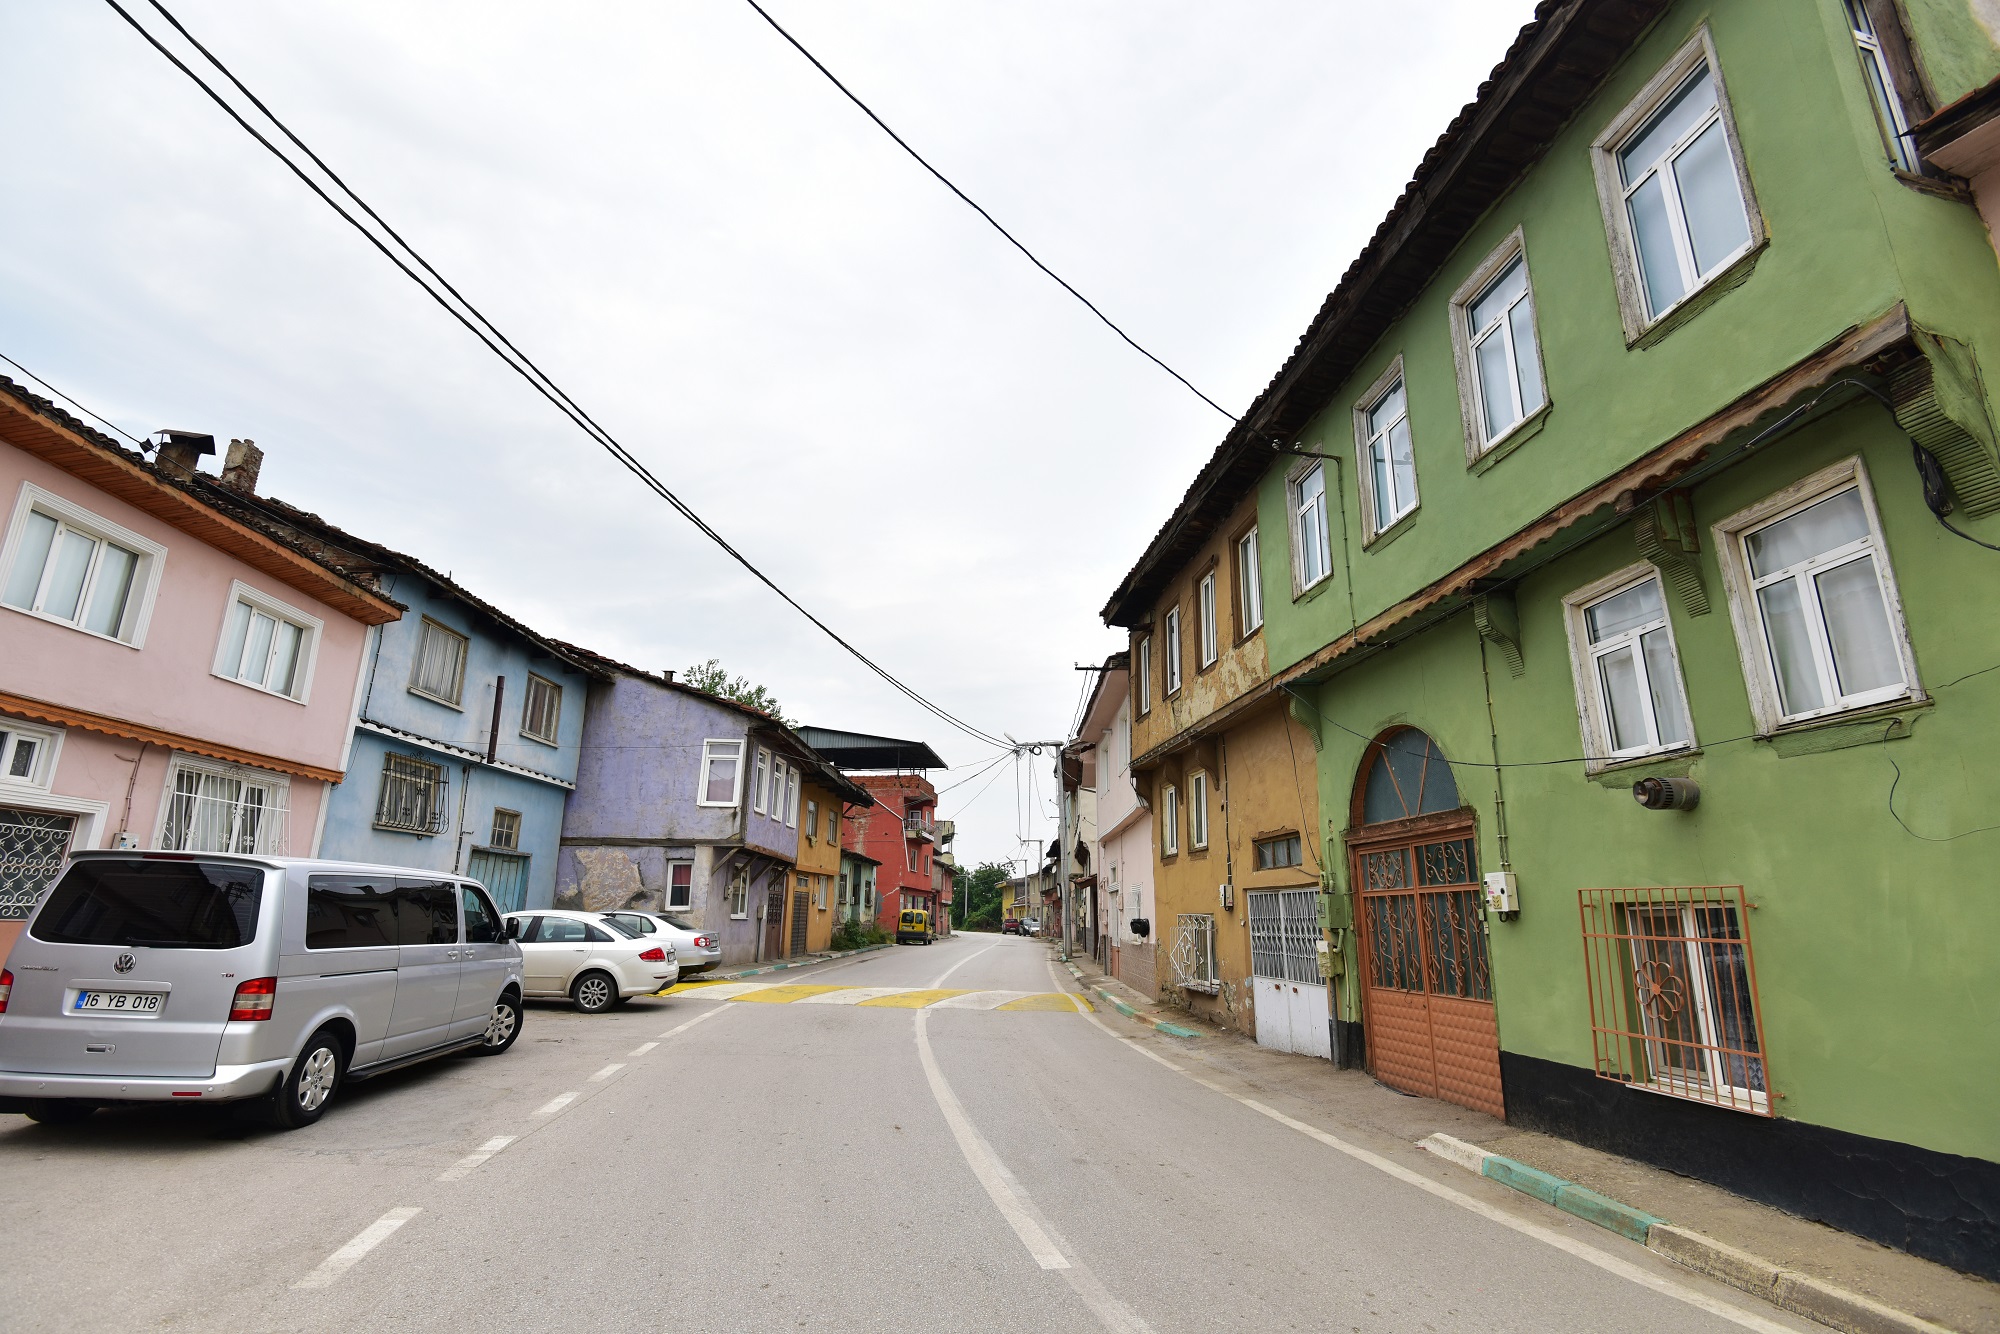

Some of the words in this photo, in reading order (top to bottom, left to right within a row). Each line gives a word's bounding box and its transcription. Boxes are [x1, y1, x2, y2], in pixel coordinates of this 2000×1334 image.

[84, 994, 101, 1007] 16
[107, 994, 127, 1008] YB
[132, 996, 159, 1009] 018
